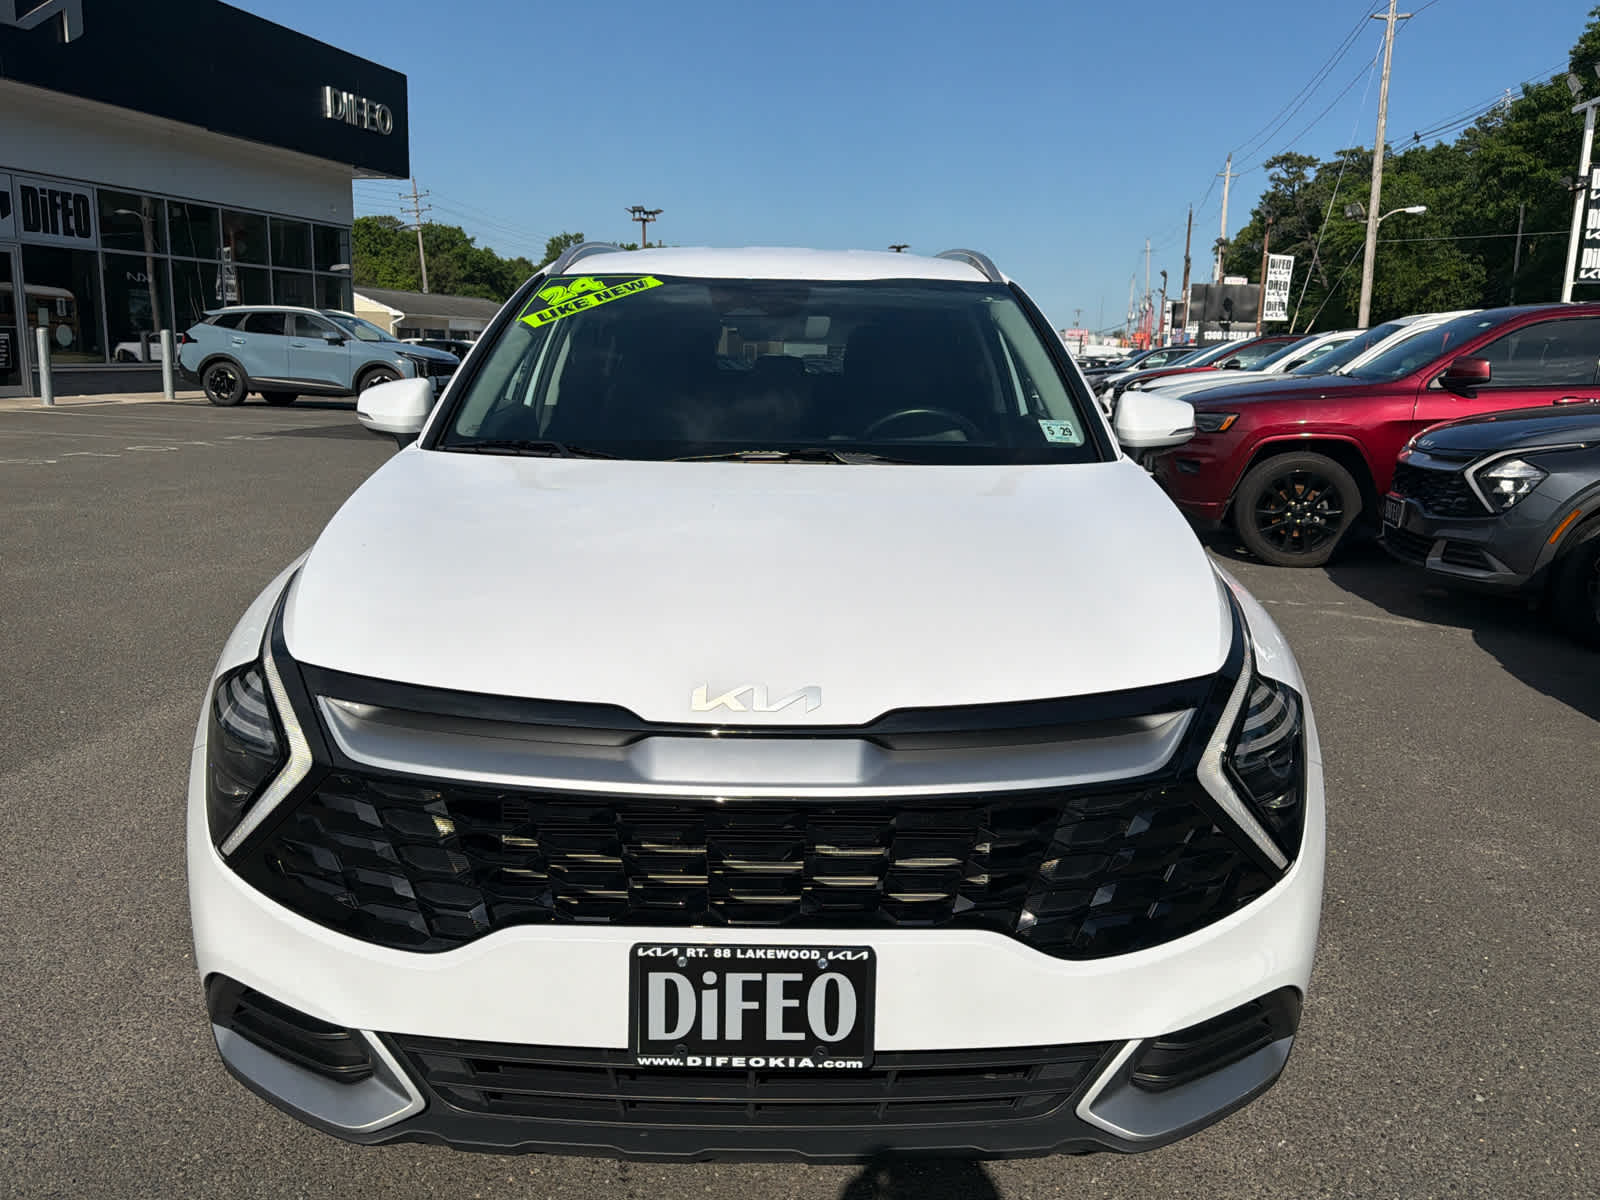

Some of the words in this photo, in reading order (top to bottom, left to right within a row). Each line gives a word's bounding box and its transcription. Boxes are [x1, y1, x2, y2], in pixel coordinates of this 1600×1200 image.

[20, 185, 91, 238] DiFEO
[536, 298, 591, 322] LIKE
[595, 279, 649, 302] NEW
[538, 277, 607, 305] 24
[1046, 426, 1055, 436] 5
[1059, 426, 1073, 437] 29
[691, 681, 822, 713] KIA
[637, 947, 679, 957] KIA
[686, 947, 709, 958] RT.
[713, 948, 731, 958] 88
[736, 948, 821, 960] LAKEWOOD
[827, 950, 869, 961] KIA
[648, 970, 857, 1042] DiFEO
[637, 1056, 863, 1068] www.DIFEOKIA.com
